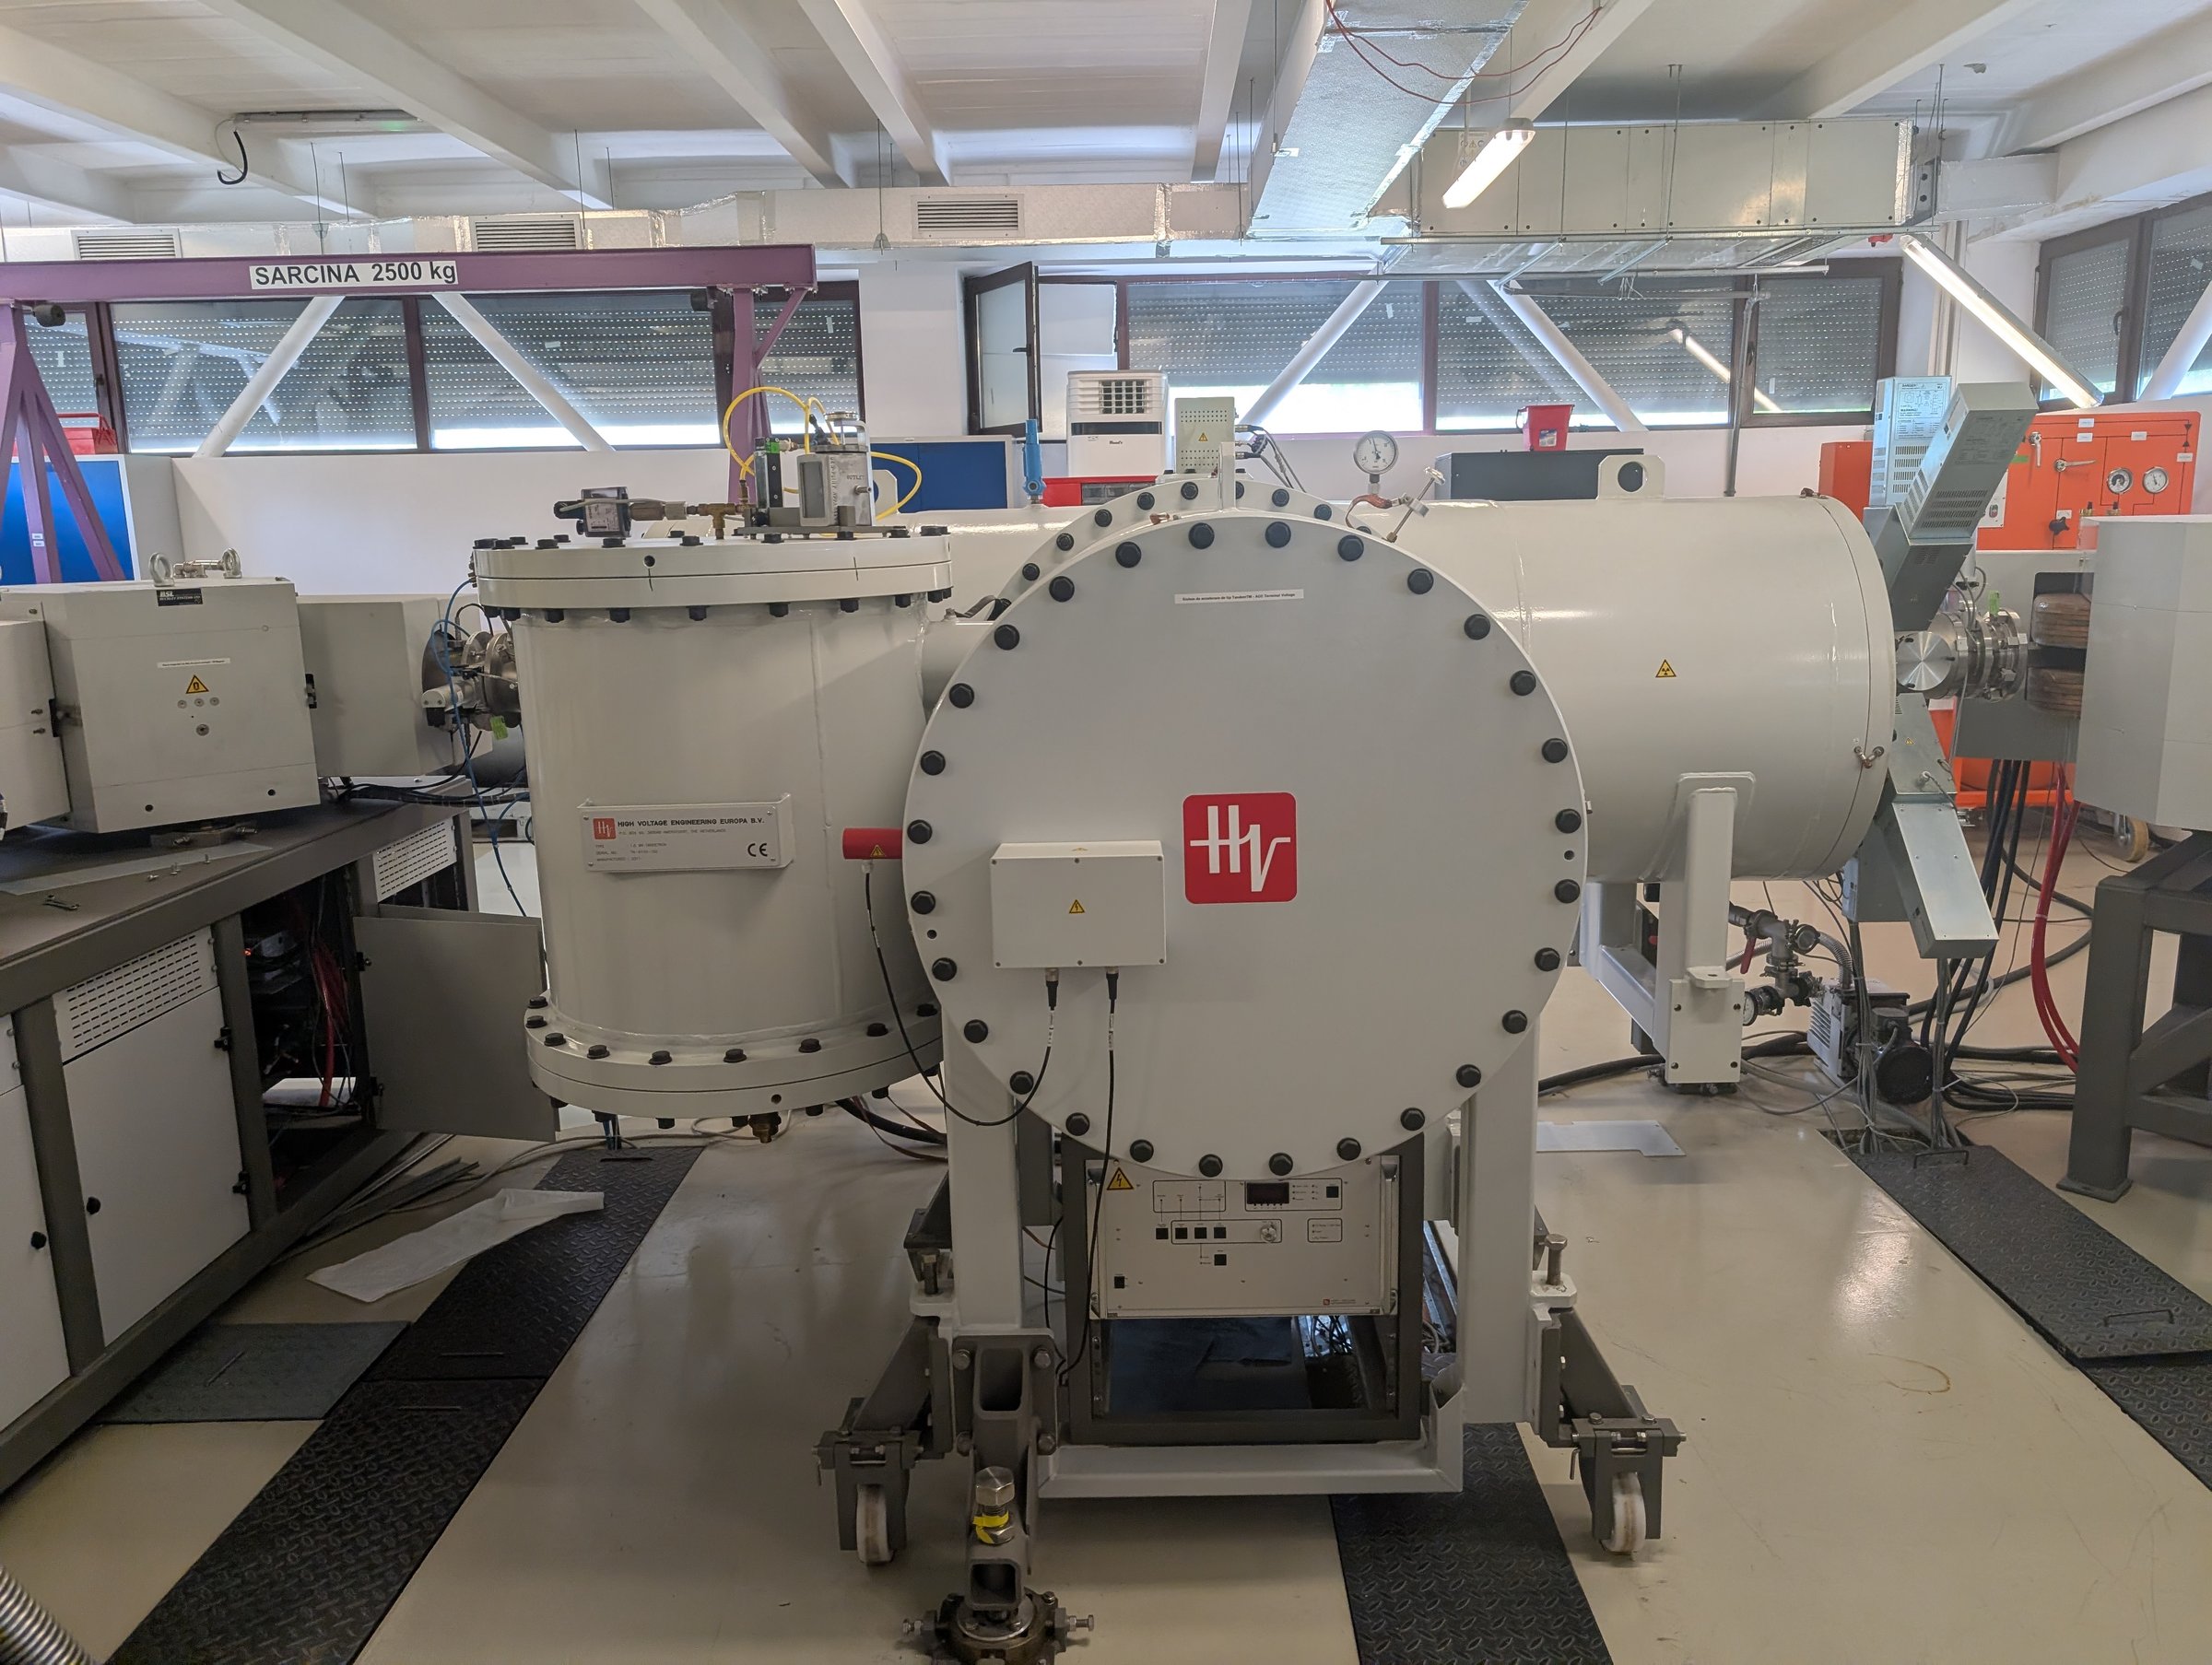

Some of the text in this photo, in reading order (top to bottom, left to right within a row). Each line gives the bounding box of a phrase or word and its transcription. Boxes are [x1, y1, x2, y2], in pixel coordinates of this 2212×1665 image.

[254, 261, 456, 286] SARCINA 2500 kg
